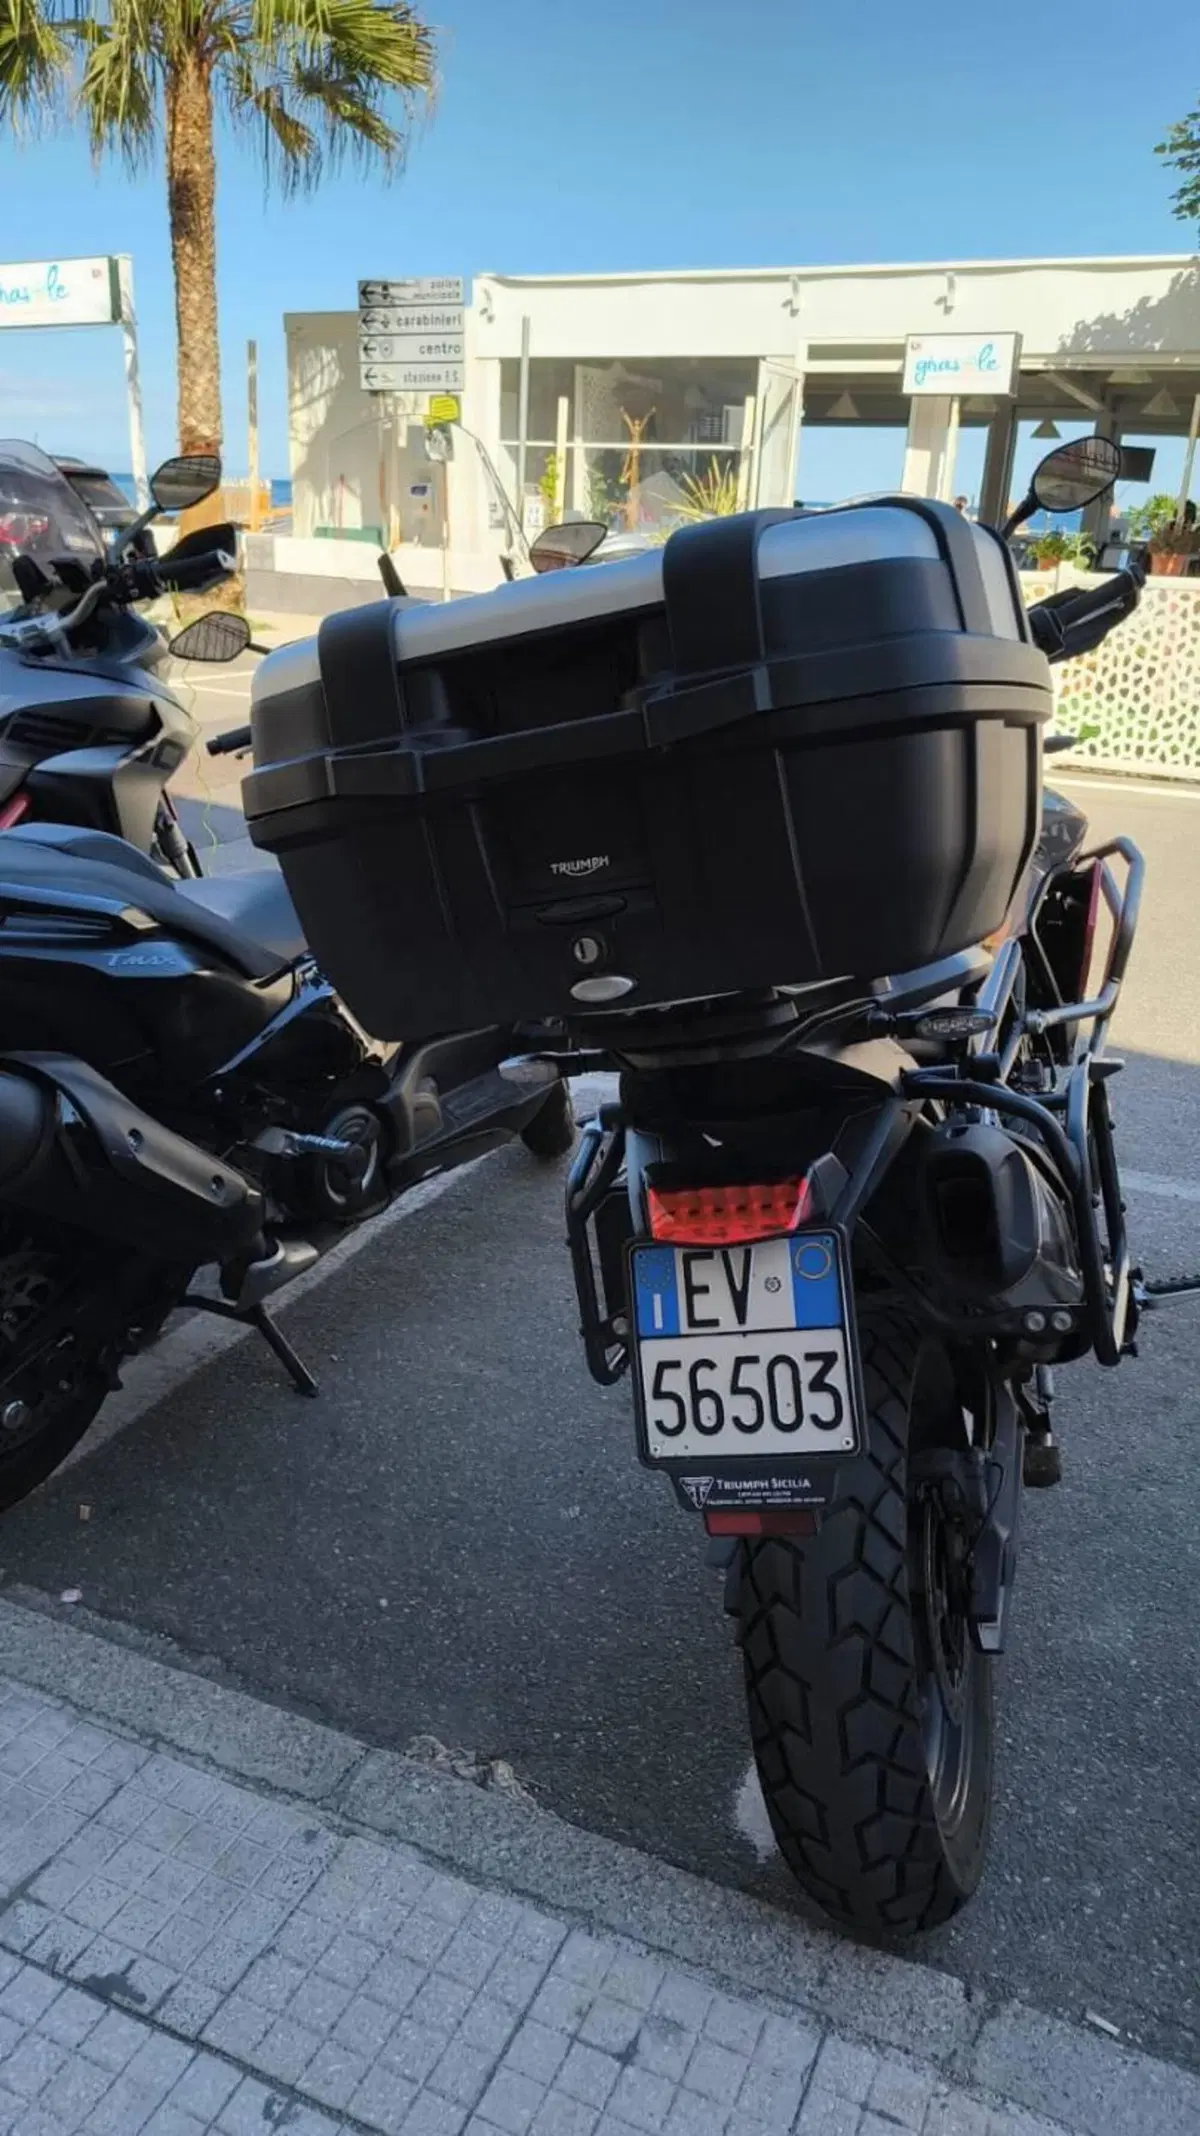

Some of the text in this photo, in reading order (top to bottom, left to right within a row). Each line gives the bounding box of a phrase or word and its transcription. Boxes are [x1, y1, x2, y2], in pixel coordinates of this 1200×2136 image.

[396, 314, 461, 327] carabinieri
[419, 343, 461, 355] centro
[551, 856, 609, 876] TRIUMPH
[682, 1249, 752, 1328] EV
[652, 1351, 843, 1437] 56503
